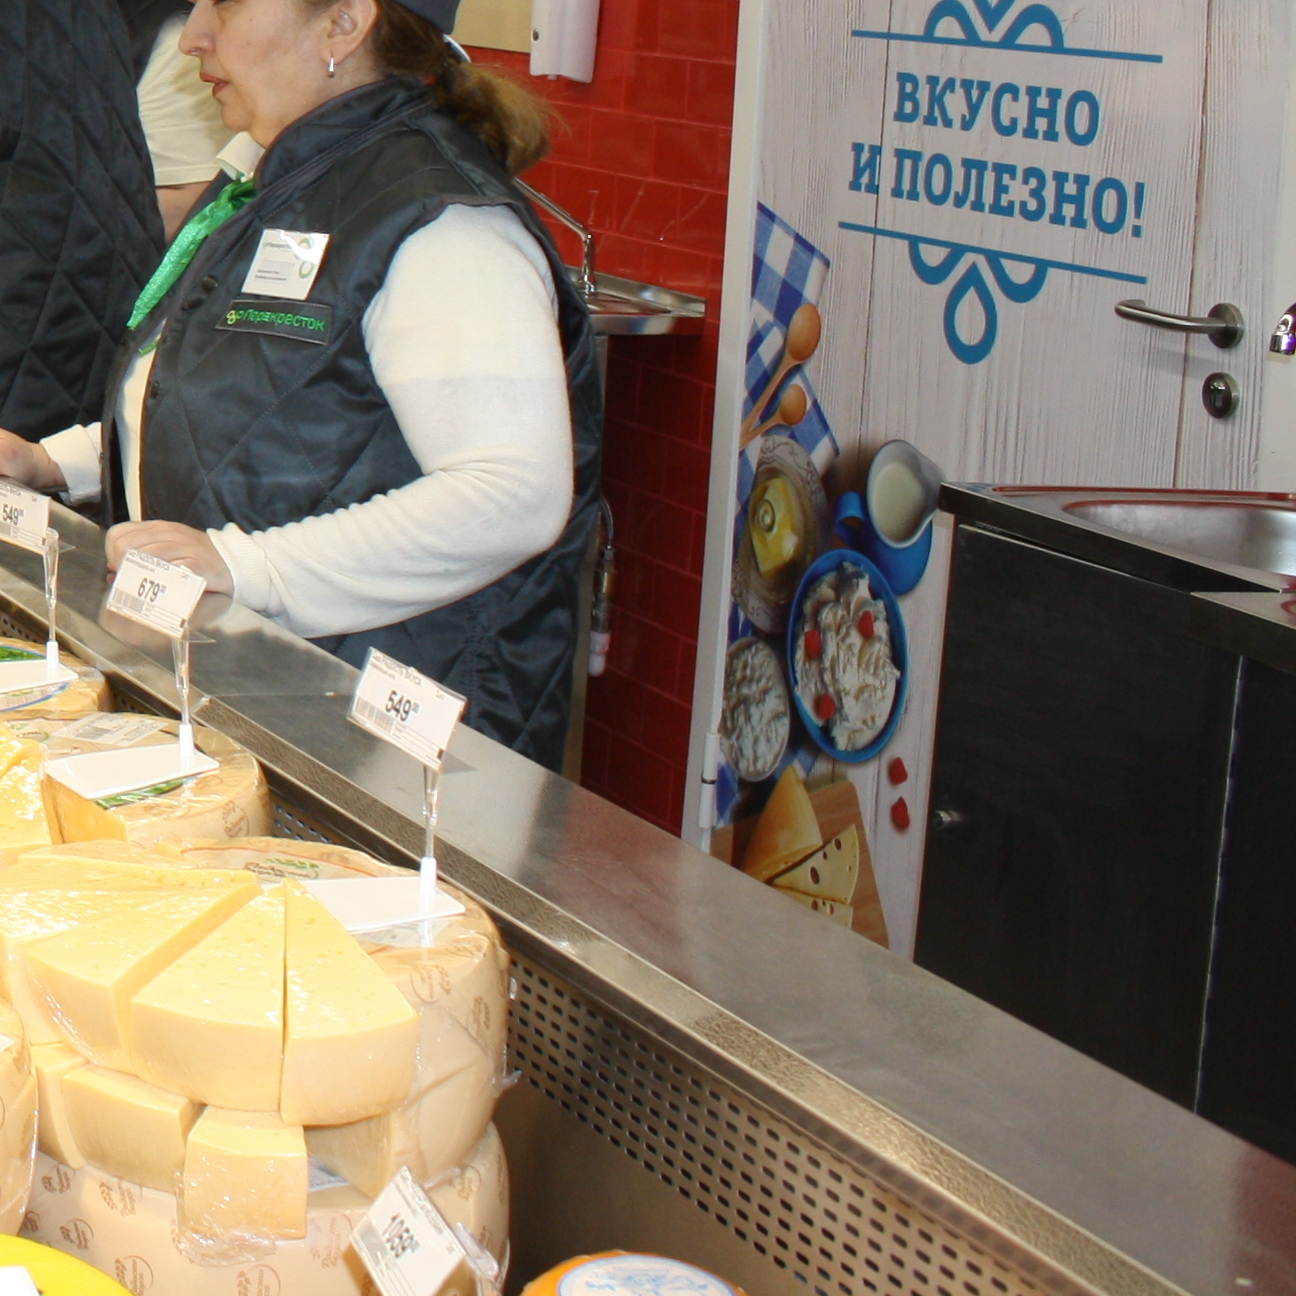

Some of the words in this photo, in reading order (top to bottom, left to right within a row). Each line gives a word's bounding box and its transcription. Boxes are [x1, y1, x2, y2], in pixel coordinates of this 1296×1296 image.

[893, 71, 1101, 146] ВКУСНО
[848, 142, 881, 194] И
[890, 148, 1147, 238] ПОЛЕЗНО!
[2, 503, 18, 526] 549
[135, 576, 161, 603] 679
[383, 688, 413, 723] 549
